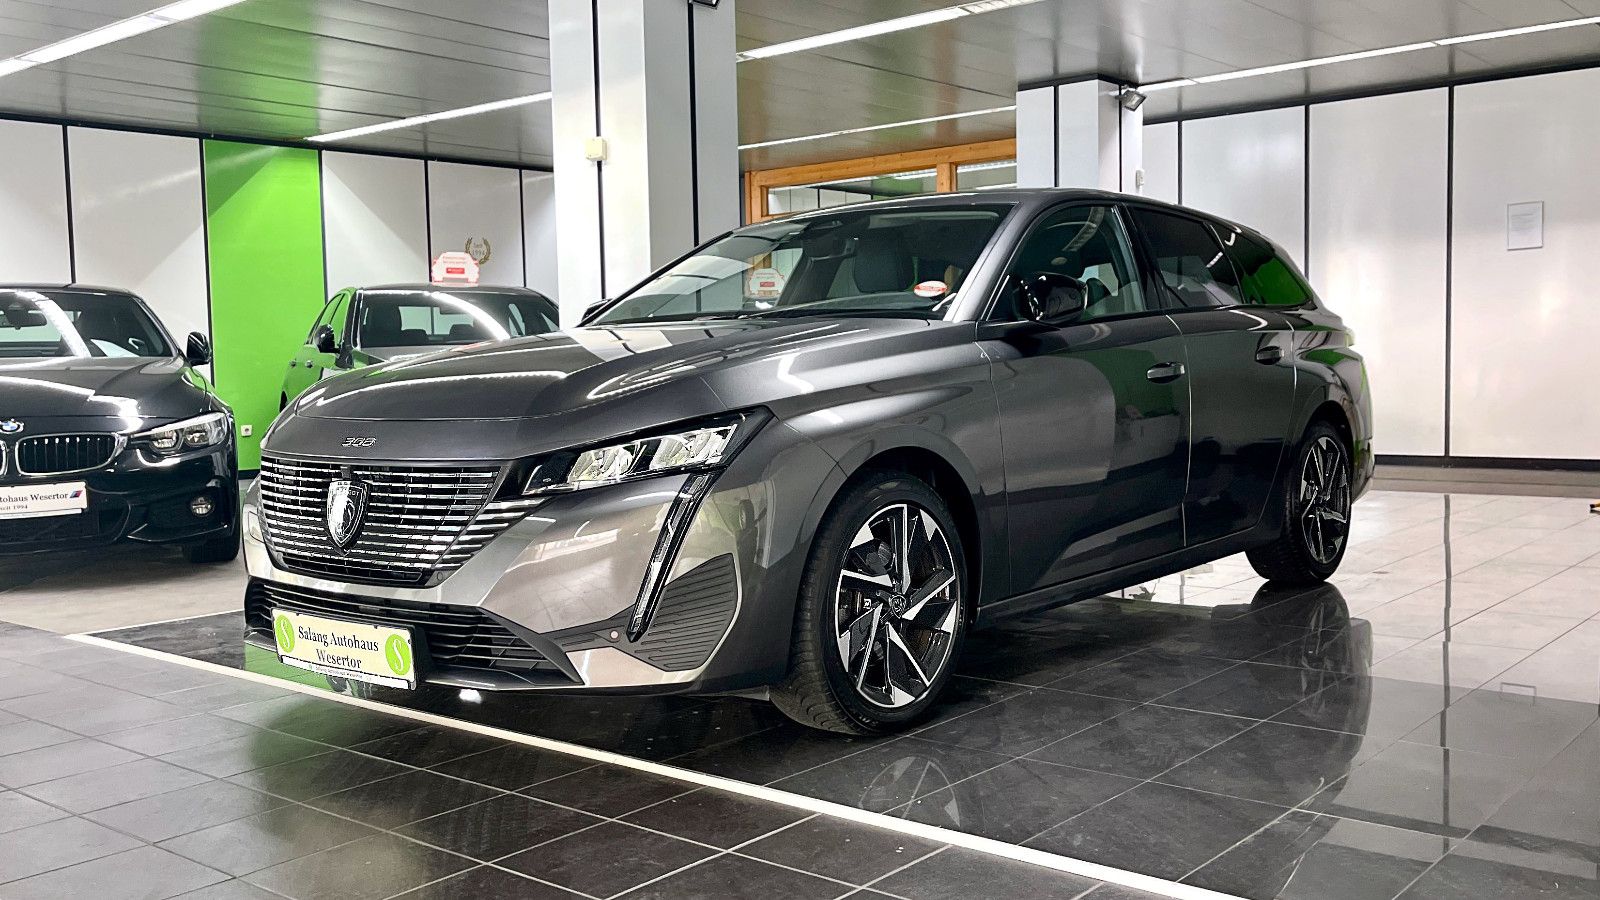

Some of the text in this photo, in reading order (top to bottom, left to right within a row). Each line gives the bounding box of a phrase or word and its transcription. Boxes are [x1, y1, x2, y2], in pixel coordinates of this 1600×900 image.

[341, 437, 376, 448] 308
[30, 493, 68, 501] Wesertor
[298, 625, 379, 651] Salang Autohaus
[316, 648, 362, 669] Wesertor
